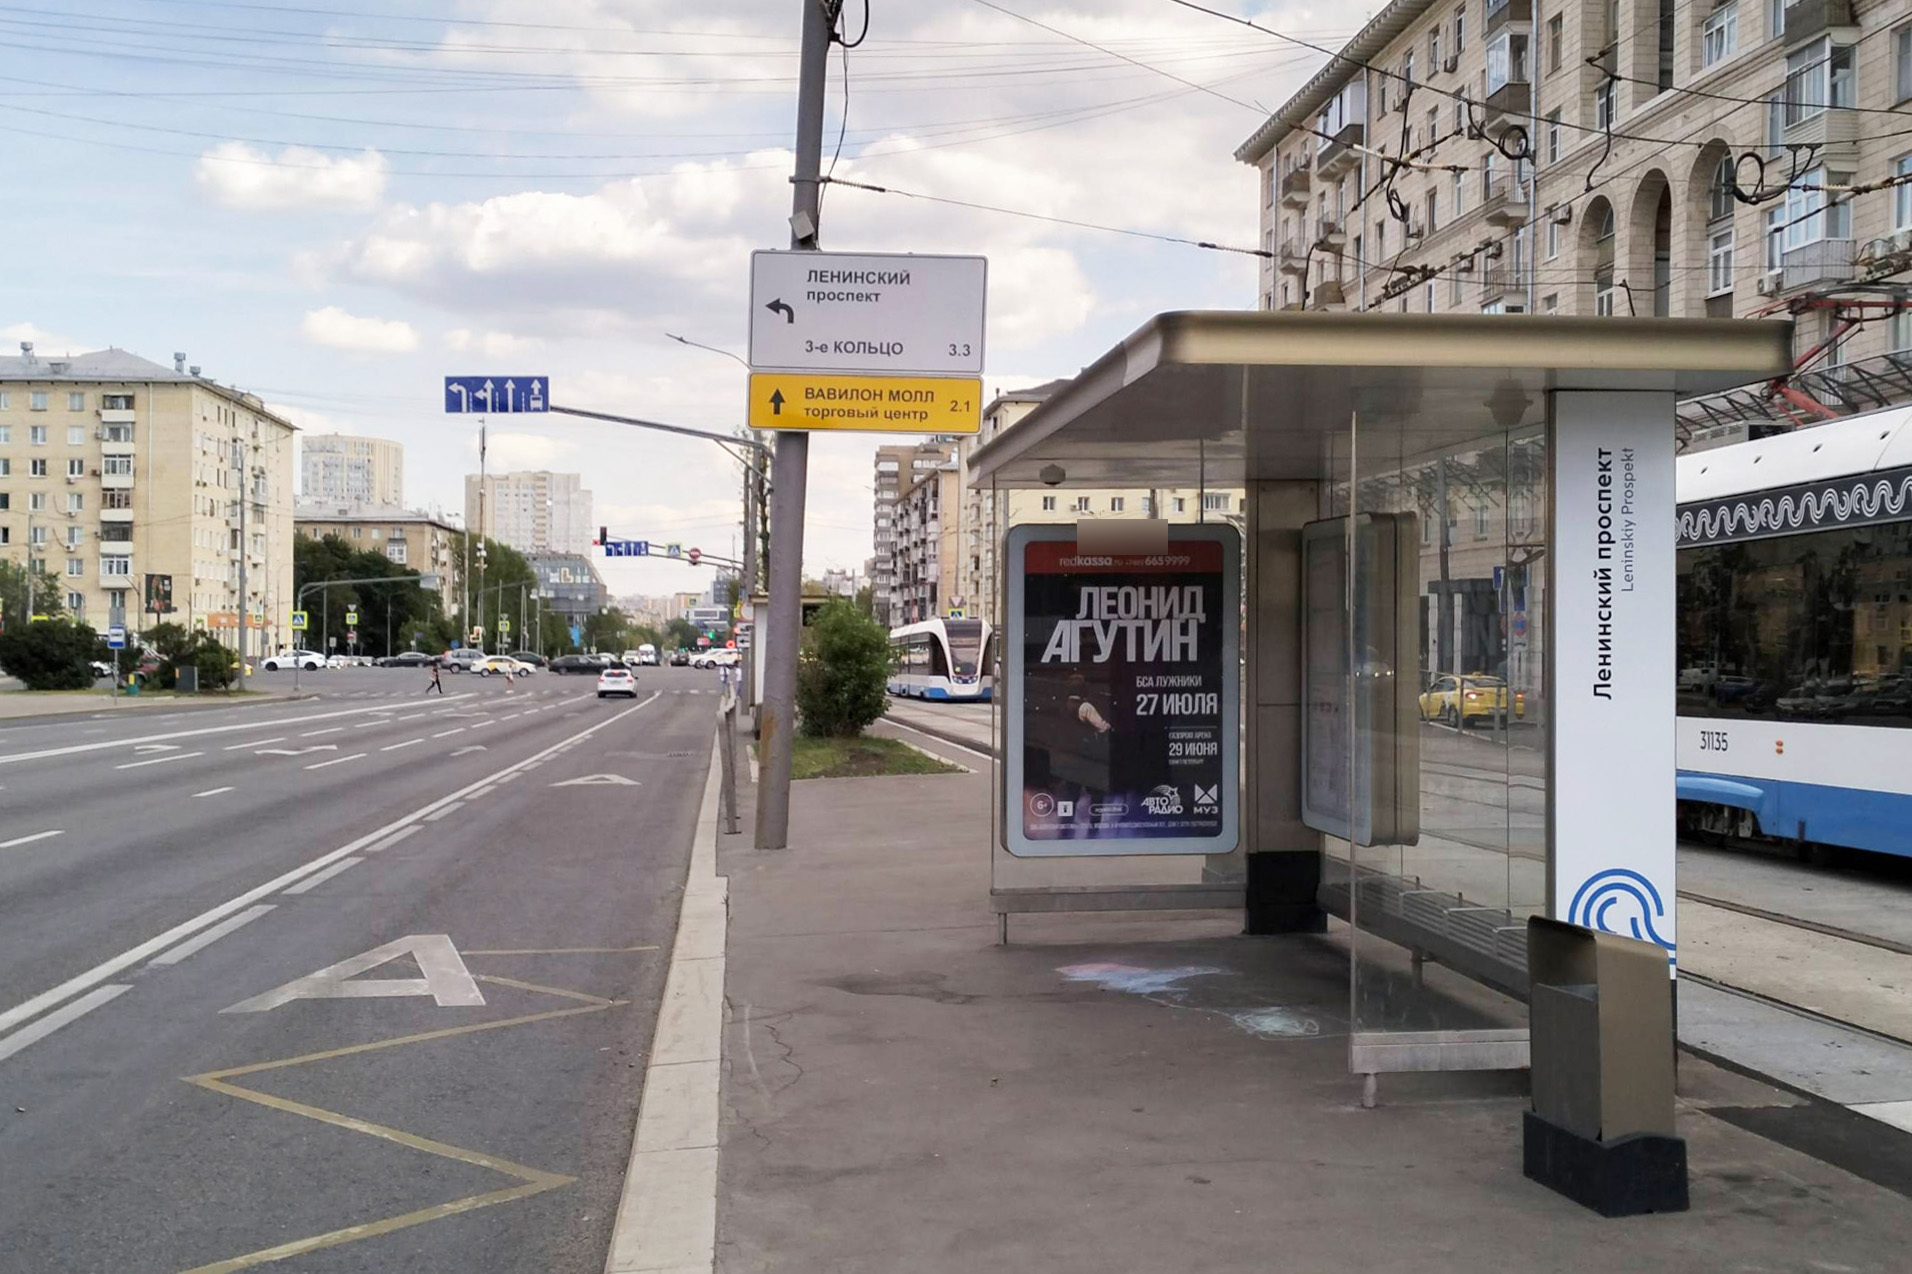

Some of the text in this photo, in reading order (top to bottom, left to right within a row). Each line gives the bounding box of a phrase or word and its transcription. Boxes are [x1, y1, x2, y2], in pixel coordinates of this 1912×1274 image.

[807, 269, 911, 286] ЛЕНИНСКИЙ
[806, 289, 881, 303] проспект
[805, 340, 971, 357] 3-е КОЛЬЦО 3.3
[804, 388, 971, 412] ВАВИЛОН МОЛЛ 2.1
[804, 407, 929, 422] торговый центр
[1621, 447, 1637, 592] Leninskiy Prospekt
[1593, 447, 1616, 701] Ленинский проспект
[1075, 585, 1207, 623] ЛЕОНИД
[1040, 618, 1198, 664] АГУТИН
[1136, 675, 1202, 688] БСА ЛУЖНИКИ
[1136, 692, 1218, 716] 27 ИЮЛЯ
[1168, 742, 1218, 756] 29 ИЮНЯ
[1700, 730, 1729, 752] 31135
[1141, 795, 1169, 807] АВТО
[1148, 803, 1184, 815] РАДИО
[1193, 806, 1219, 814] МУЗ
